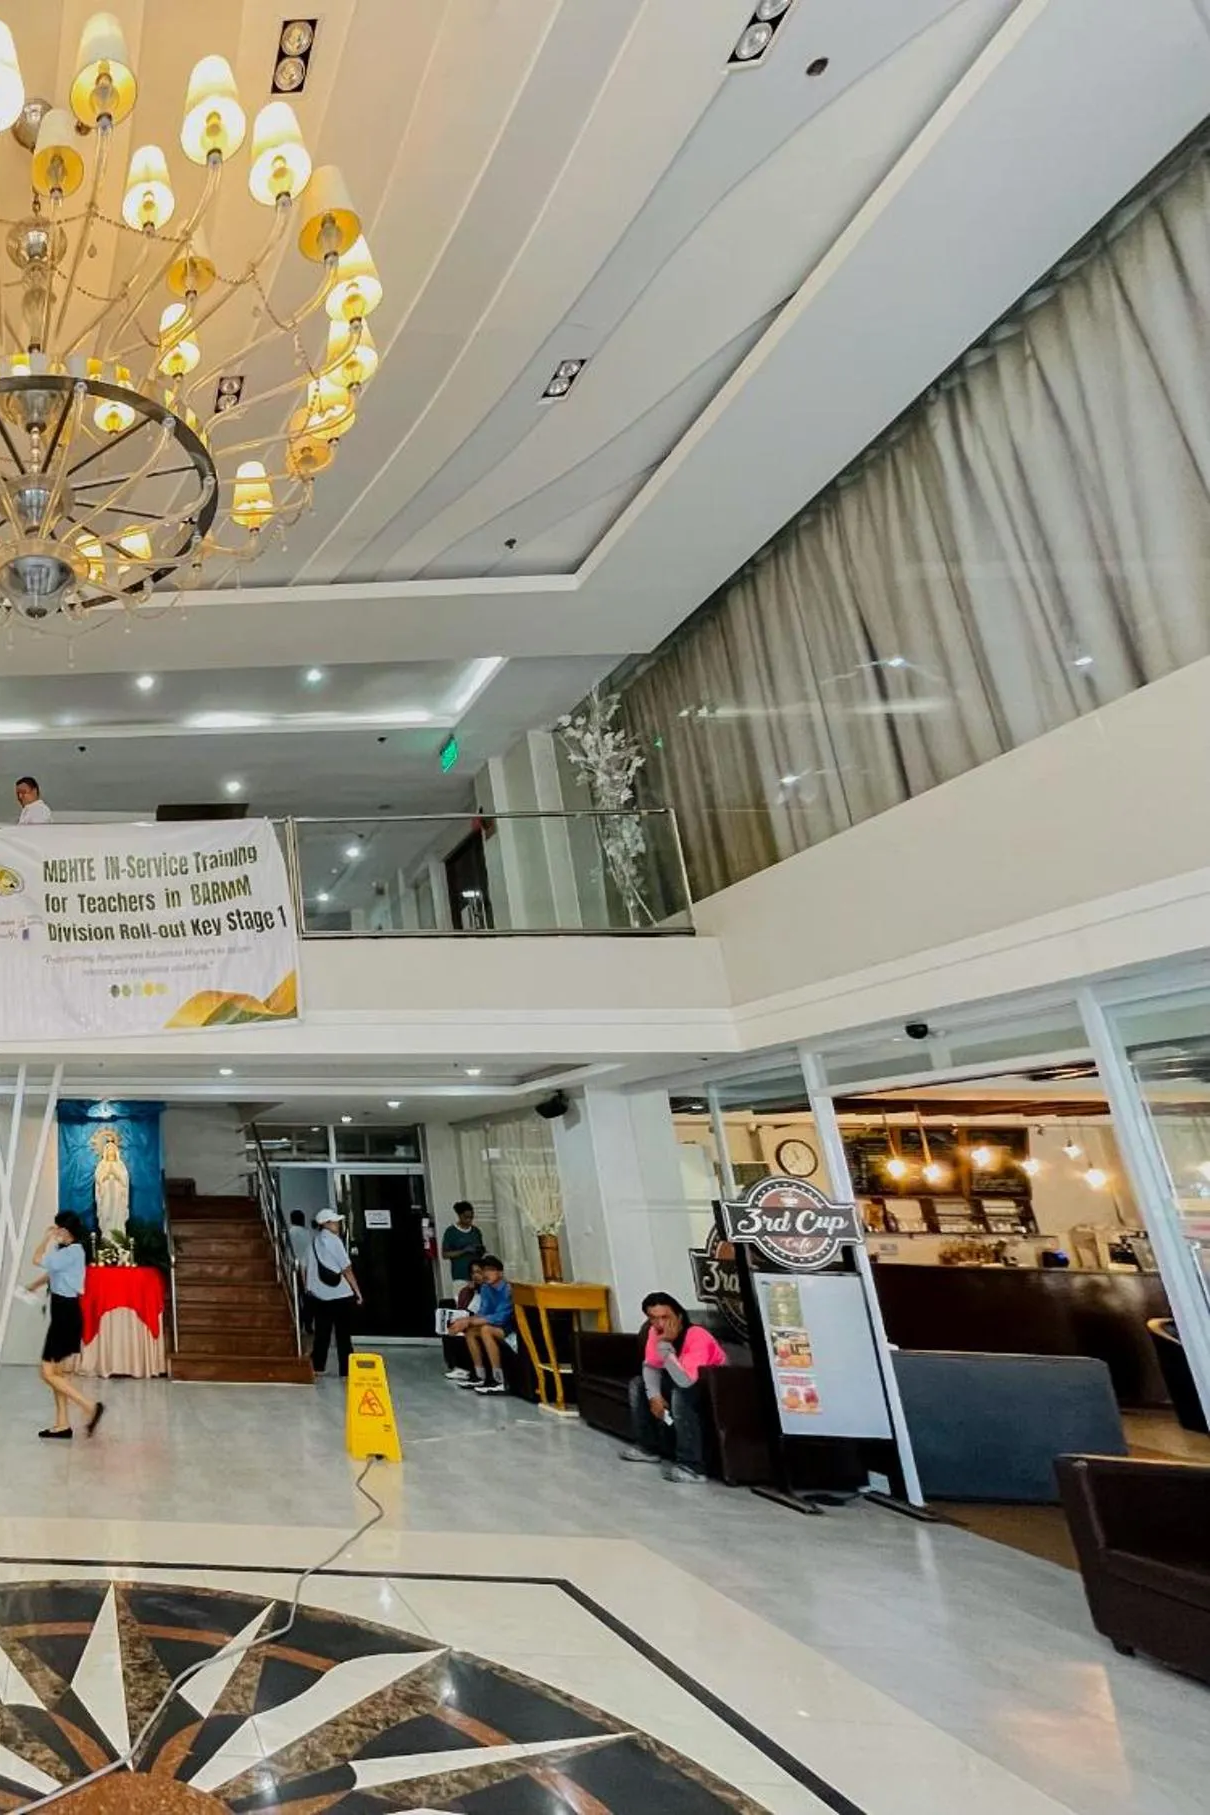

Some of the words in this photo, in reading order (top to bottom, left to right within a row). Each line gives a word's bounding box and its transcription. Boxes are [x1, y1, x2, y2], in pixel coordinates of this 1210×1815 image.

[42, 858, 96, 883] MBHTE
[104, 852, 189, 880] IN-Service
[192, 845, 258, 874] Training
[44, 893, 68, 913] for
[77, 892, 156, 914] Teachers
[164, 887, 182, 909] in
[190, 873, 252, 906] BARMM
[47, 922, 115, 943] Division
[119, 920, 187, 940] Roll-out
[190, 917, 221, 937] Key
[226, 908, 275, 933] Stage
[277, 904, 288, 928] 1
[737, 1208, 791, 1234] 3rd
[795, 1209, 850, 1235] Cup
